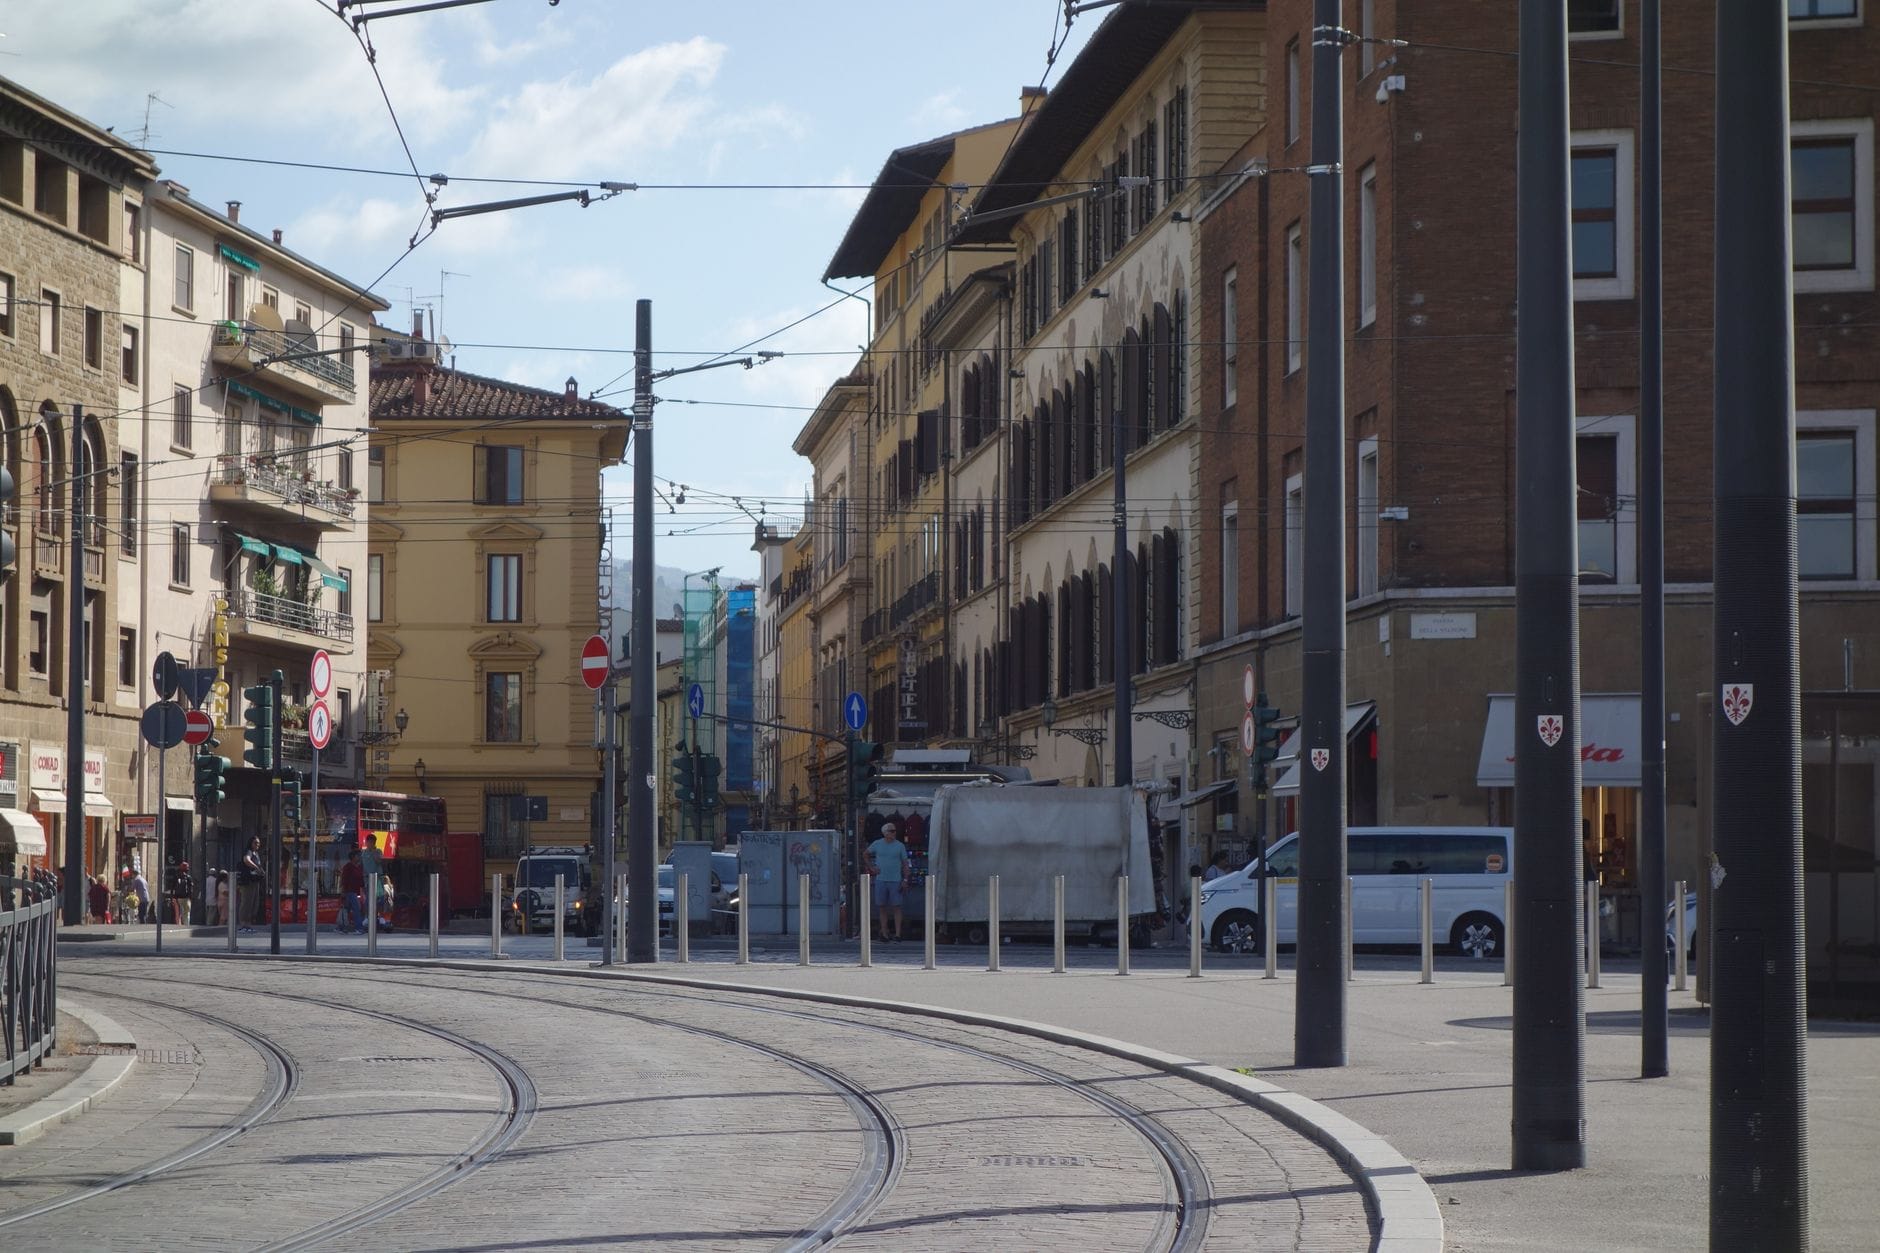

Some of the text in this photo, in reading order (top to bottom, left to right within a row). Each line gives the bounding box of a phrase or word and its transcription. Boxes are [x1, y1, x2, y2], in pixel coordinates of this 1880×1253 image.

[215, 598, 230, 730] PENSIONE
[38, 757, 58, 771] CONAD
[84, 761, 100, 774] ONAD
